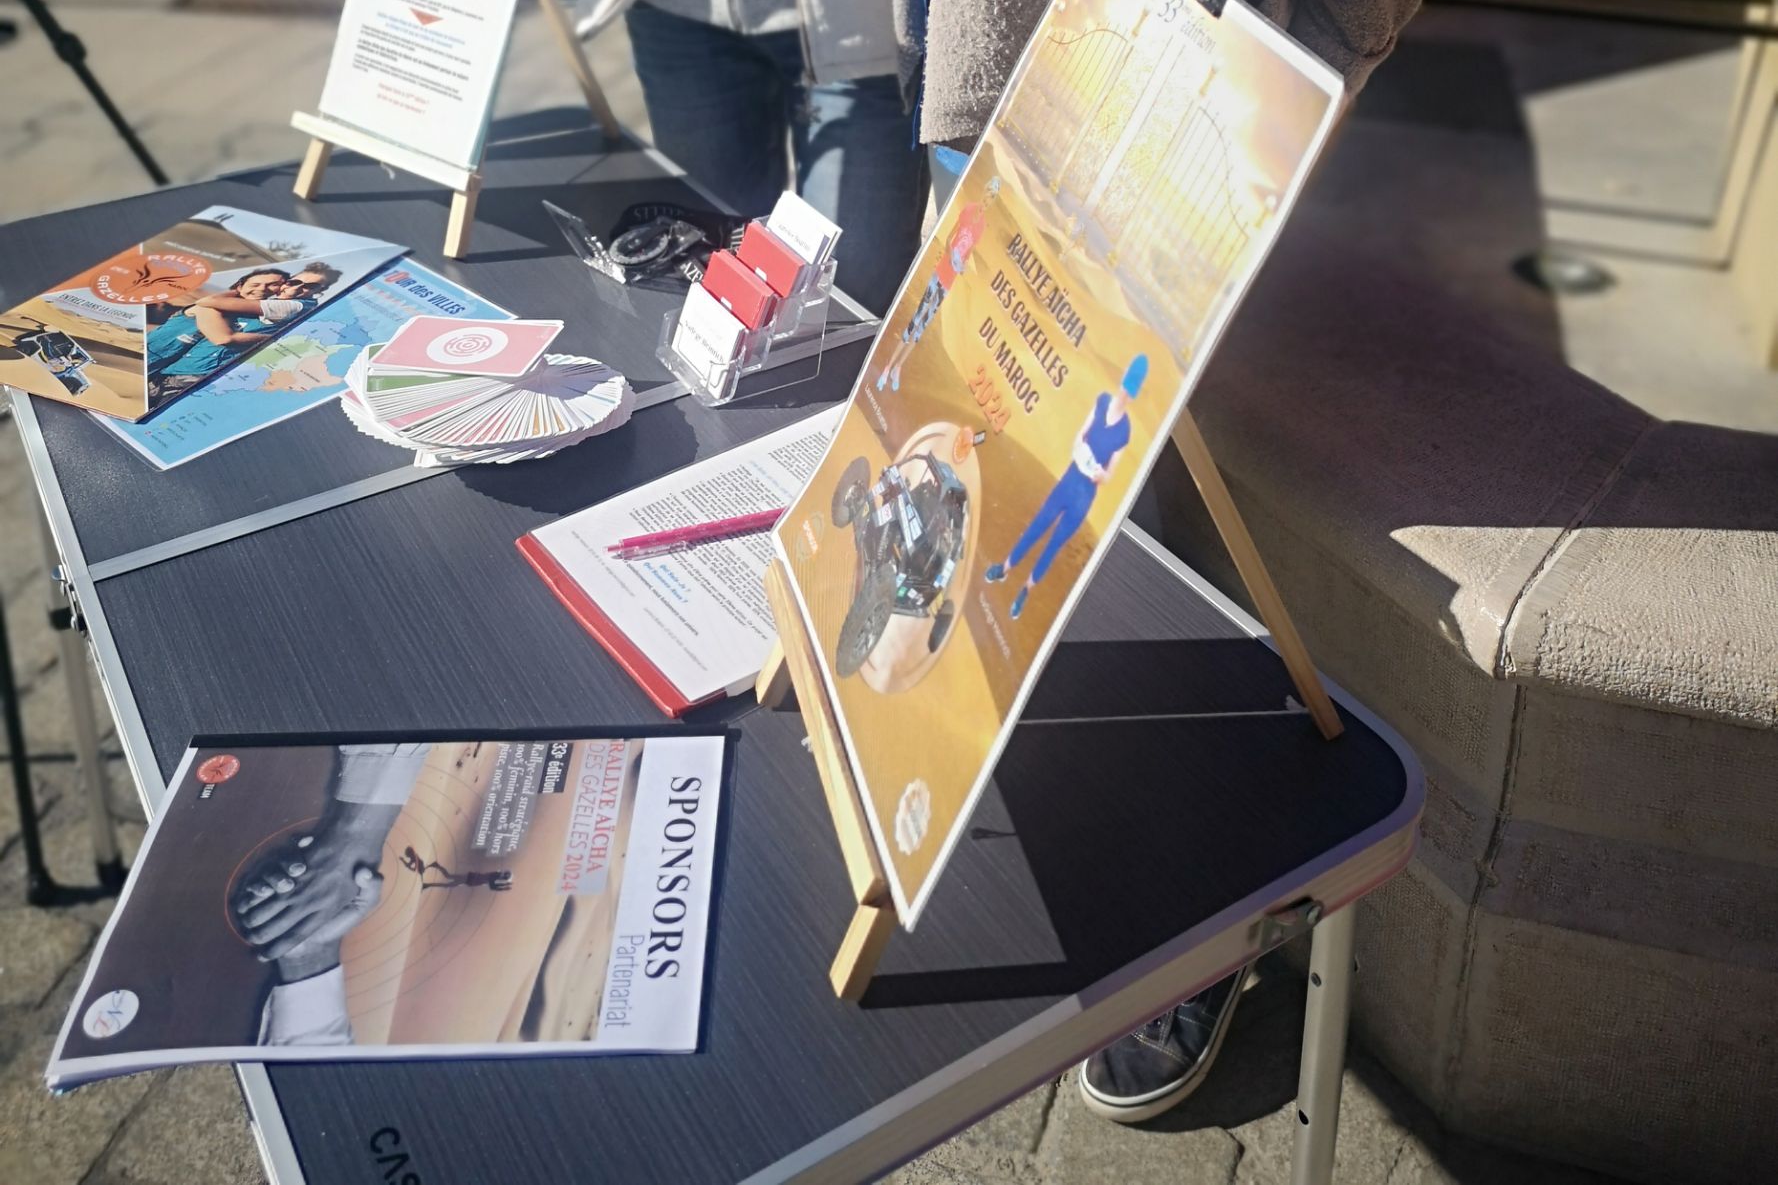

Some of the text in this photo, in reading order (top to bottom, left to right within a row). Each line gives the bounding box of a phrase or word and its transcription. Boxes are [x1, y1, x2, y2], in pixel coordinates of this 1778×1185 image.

[97, 274, 169, 303] GAZELLES
[148, 254, 206, 275] RALLYE
[410, 283, 434, 298] des
[428, 293, 466, 315] VILLES
[1007, 233, 1087, 348] RALLYE AÏCHA
[979, 317, 1040, 414] DU MAROC
[990, 270, 1069, 388] DES GAZELLES
[970, 365, 1011, 435] 2024
[501, 765, 524, 805] féminin,
[506, 743, 545, 852] Rallye-raid stratégique,
[542, 761, 565, 793] édition
[561, 743, 606, 892] DES GAZELLES 2024
[586, 741, 625, 873] RALLYE AÏCHA
[476, 792, 498, 846] orientation
[491, 832, 513, 854] hors
[645, 775, 702, 979] SPONSORS
[604, 934, 646, 1028] Partenariat
